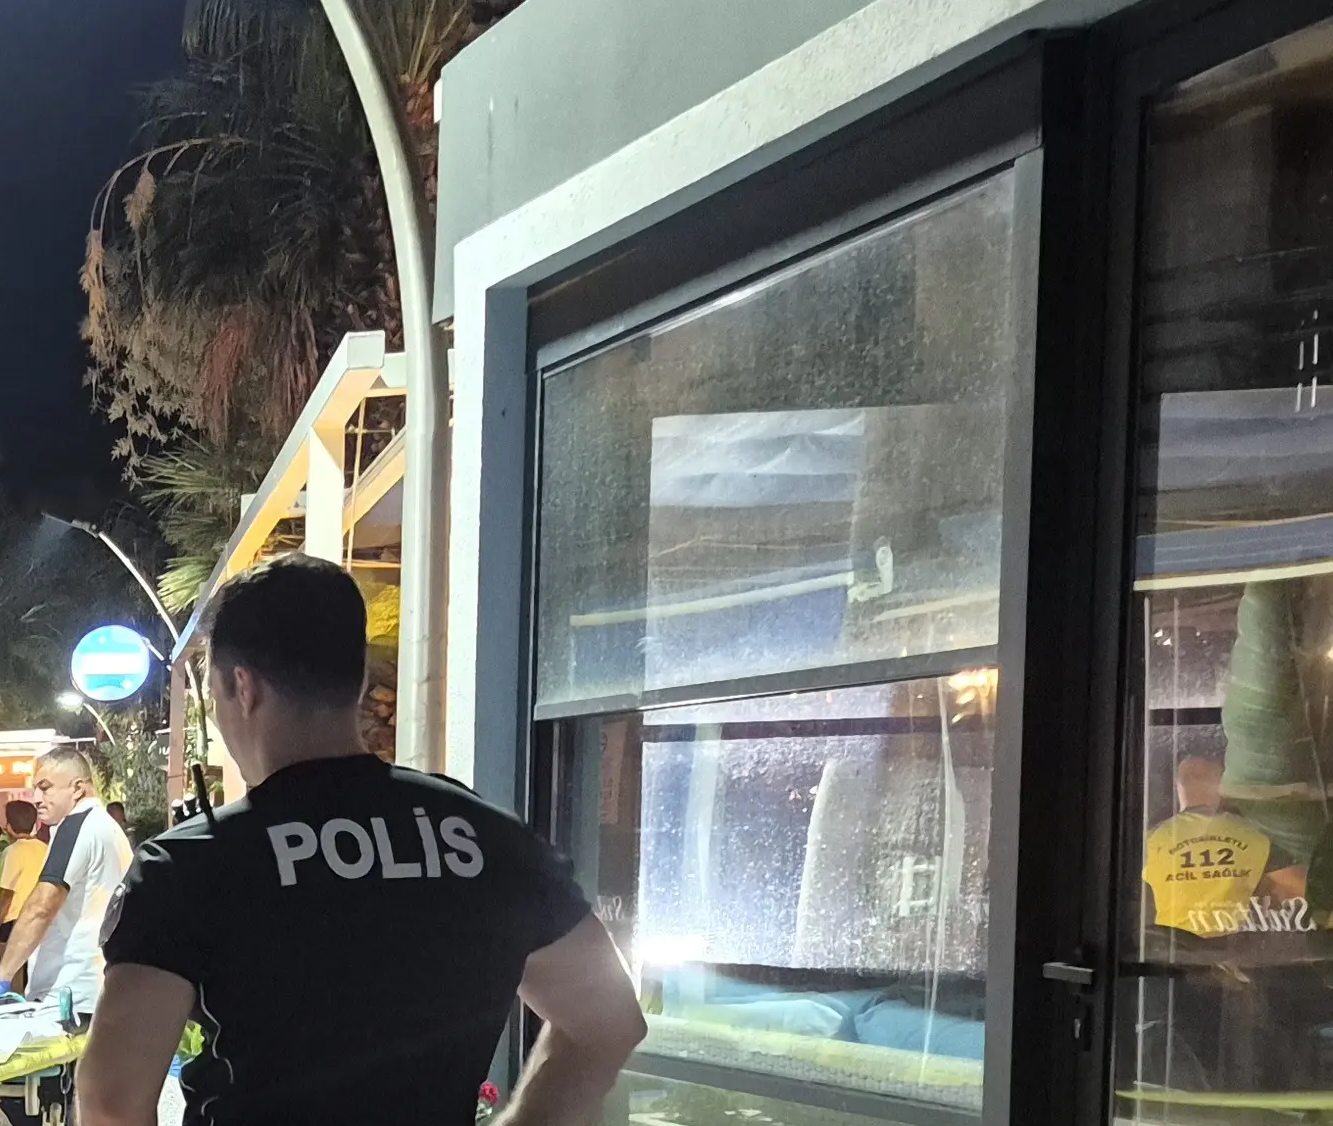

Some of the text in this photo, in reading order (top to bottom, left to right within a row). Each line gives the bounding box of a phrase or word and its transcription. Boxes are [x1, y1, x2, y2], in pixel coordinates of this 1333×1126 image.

[266, 806, 484, 887] POLİS
[1180, 848, 1235, 868] 112
[1165, 870, 1198, 882] ACİL
